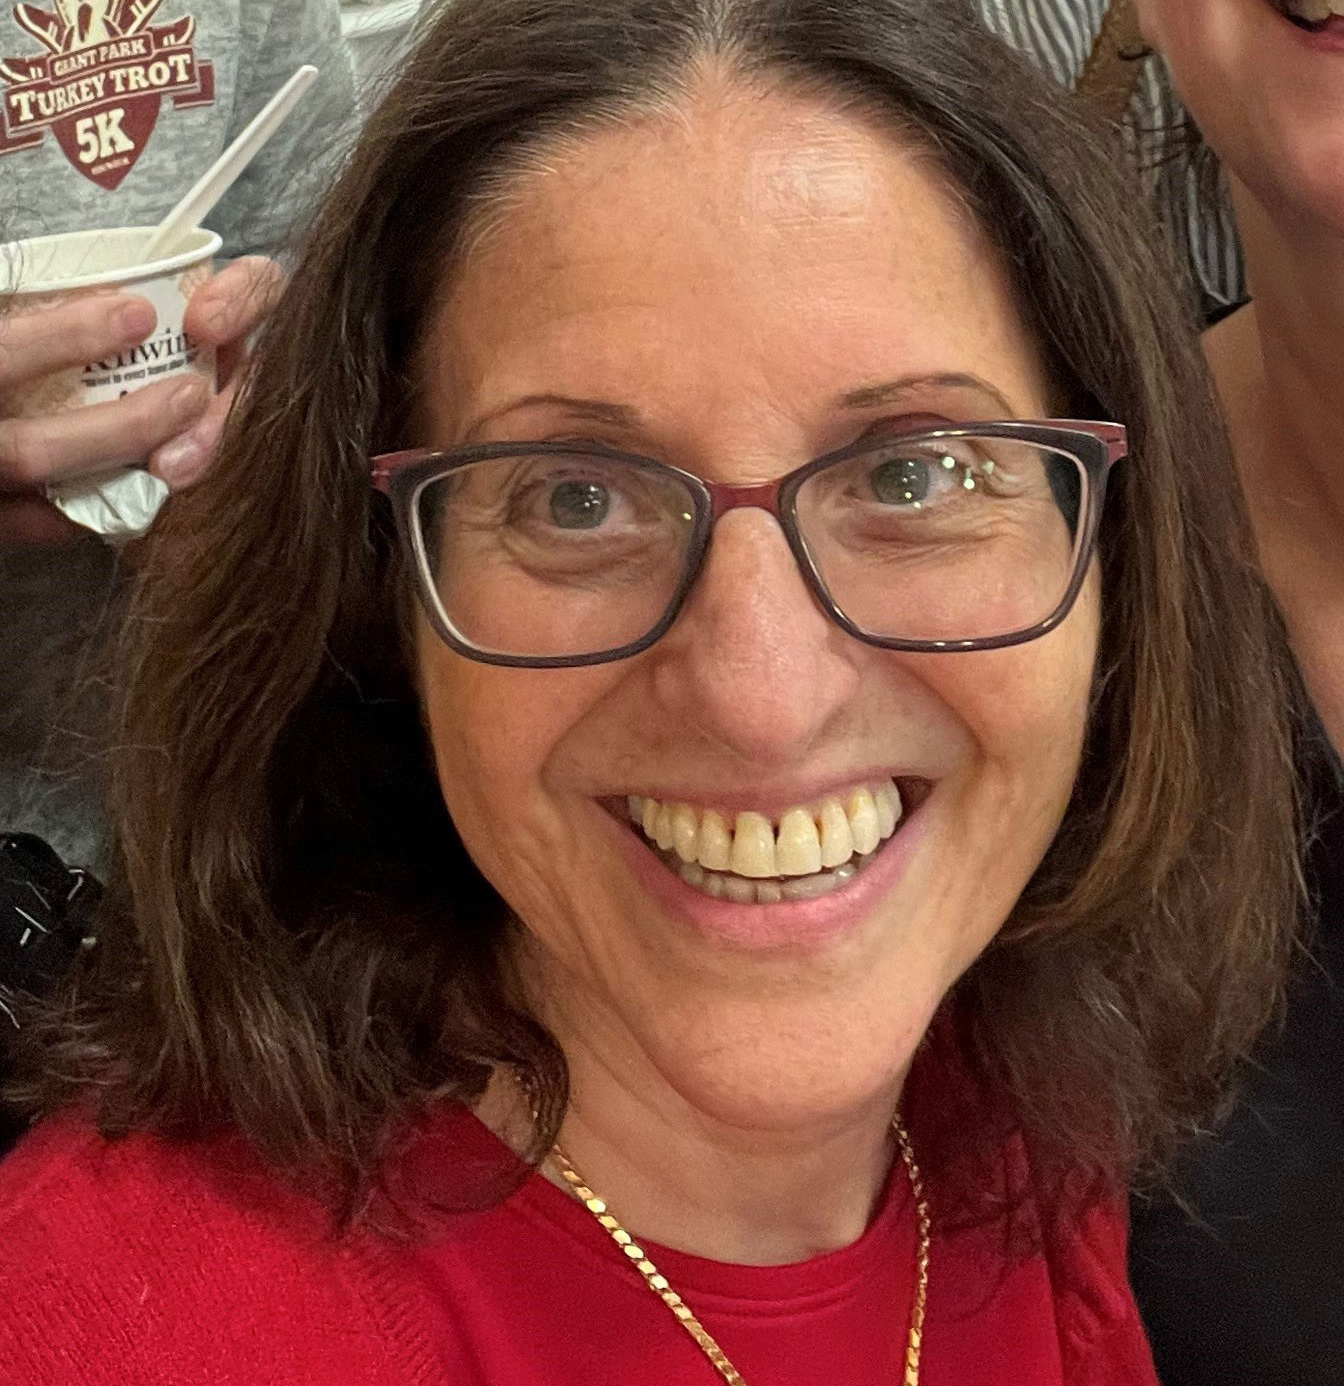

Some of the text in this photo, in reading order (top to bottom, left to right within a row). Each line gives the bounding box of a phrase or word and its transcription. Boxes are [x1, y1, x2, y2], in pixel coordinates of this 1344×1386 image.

[54, 38, 147, 77] GIANT PARK
[9, 53, 191, 122] TURKEY TROT
[74, 107, 135, 164] 5K
